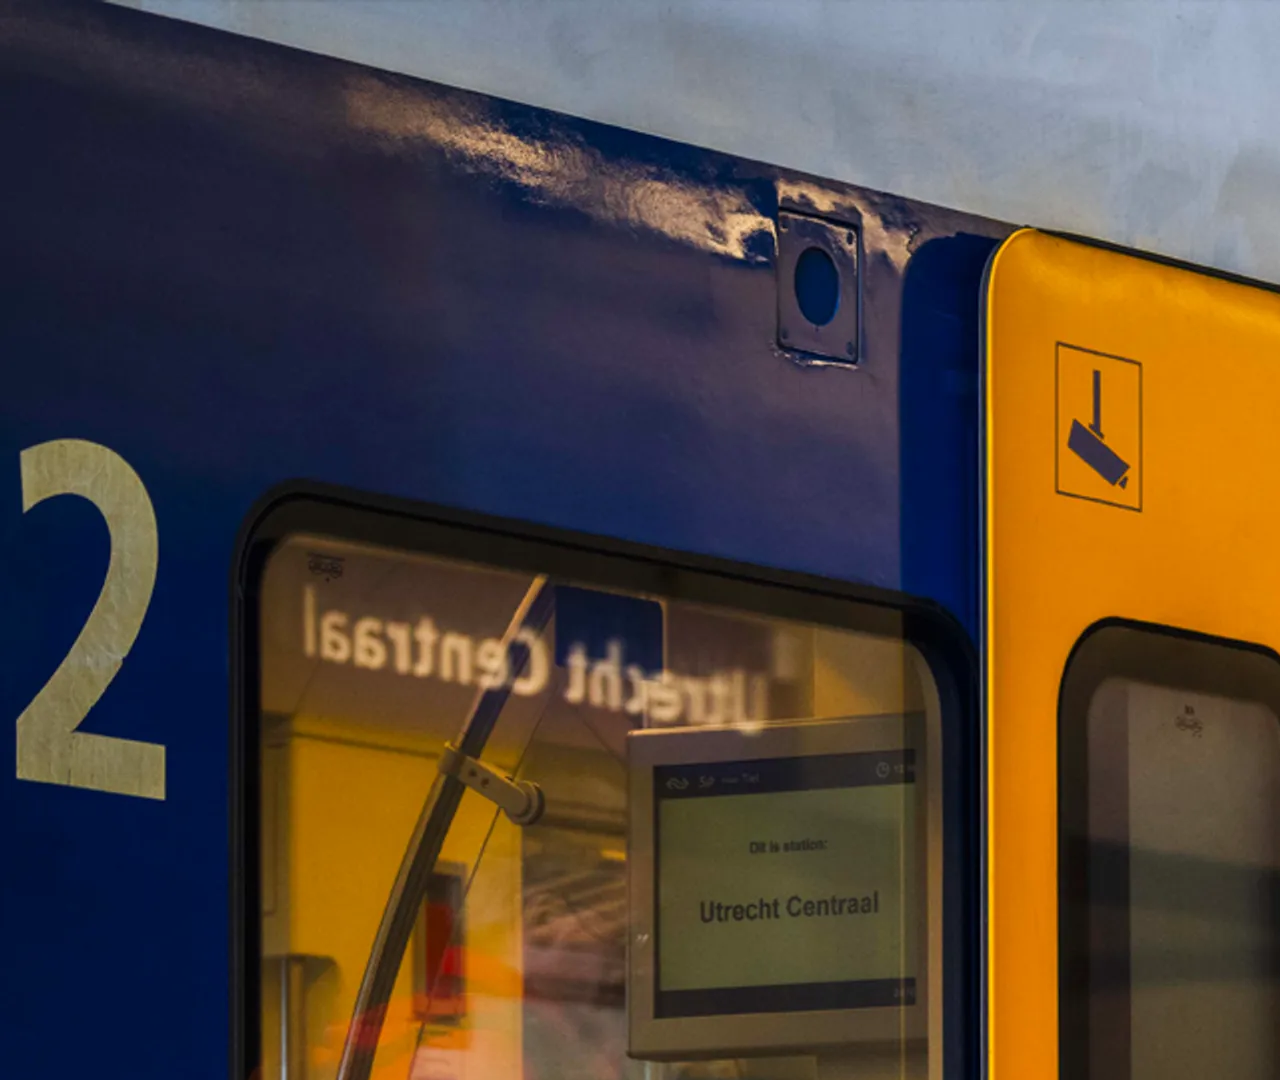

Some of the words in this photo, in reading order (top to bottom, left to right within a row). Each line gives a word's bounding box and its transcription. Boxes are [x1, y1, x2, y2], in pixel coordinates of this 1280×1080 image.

[16, 438, 166, 801] 2
[700, 899, 779, 923] Utrecht
[786, 891, 879, 917] Centraal
